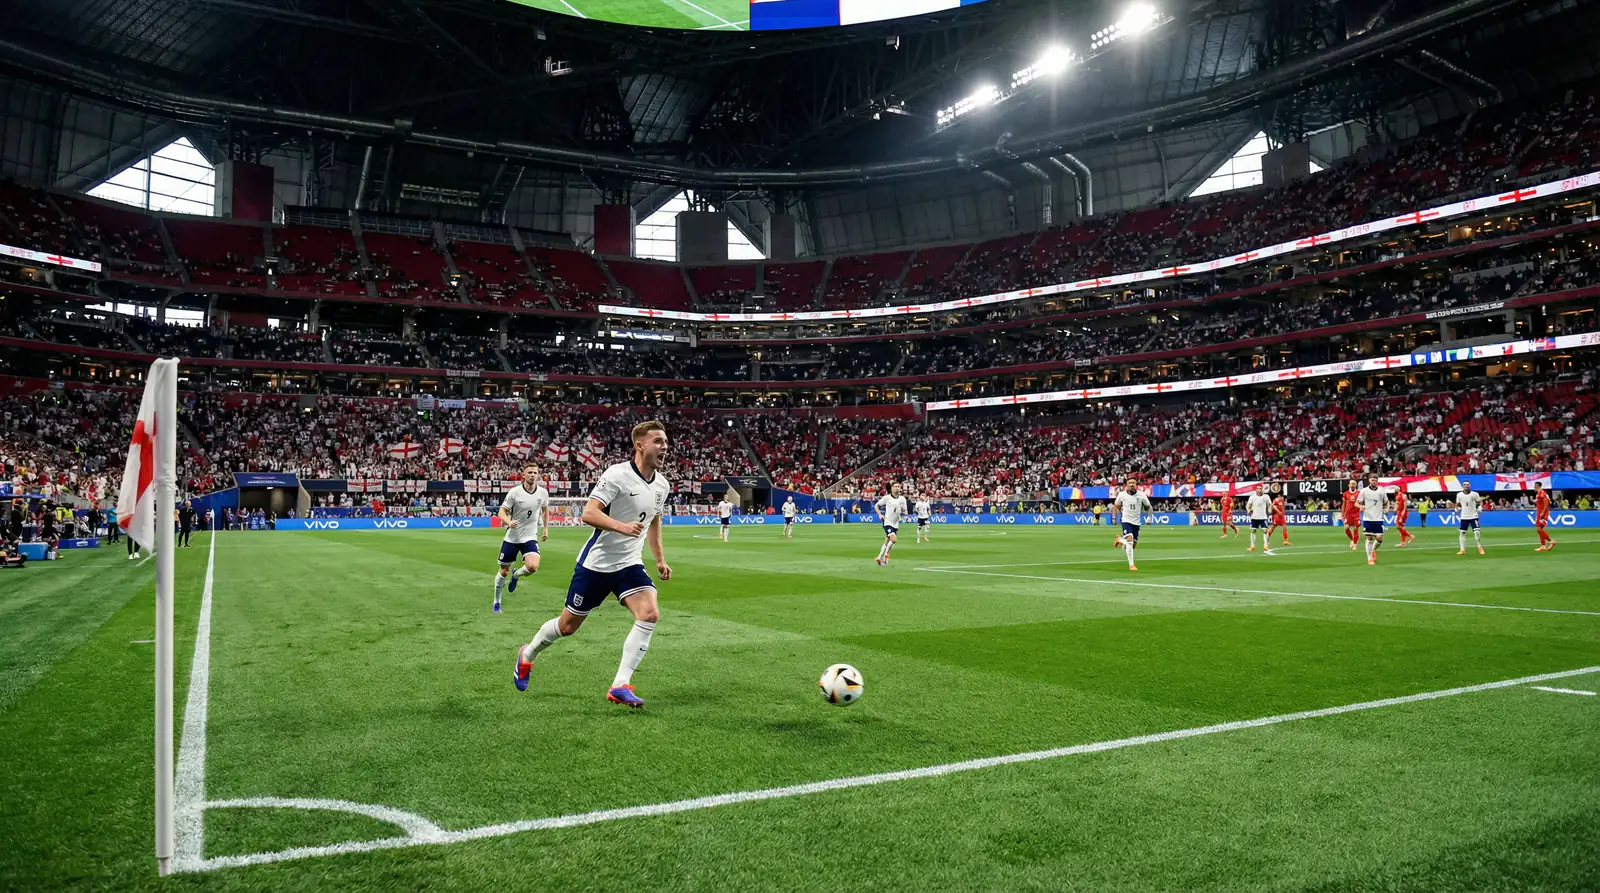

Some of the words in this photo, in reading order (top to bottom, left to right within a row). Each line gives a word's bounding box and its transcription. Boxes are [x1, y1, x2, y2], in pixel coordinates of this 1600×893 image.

[526, 509, 533, 519] 9
[639, 511, 647, 523] 2
[1202, 515, 1221, 523] UEFA
[1296, 515, 1329, 523] LEAGUE
